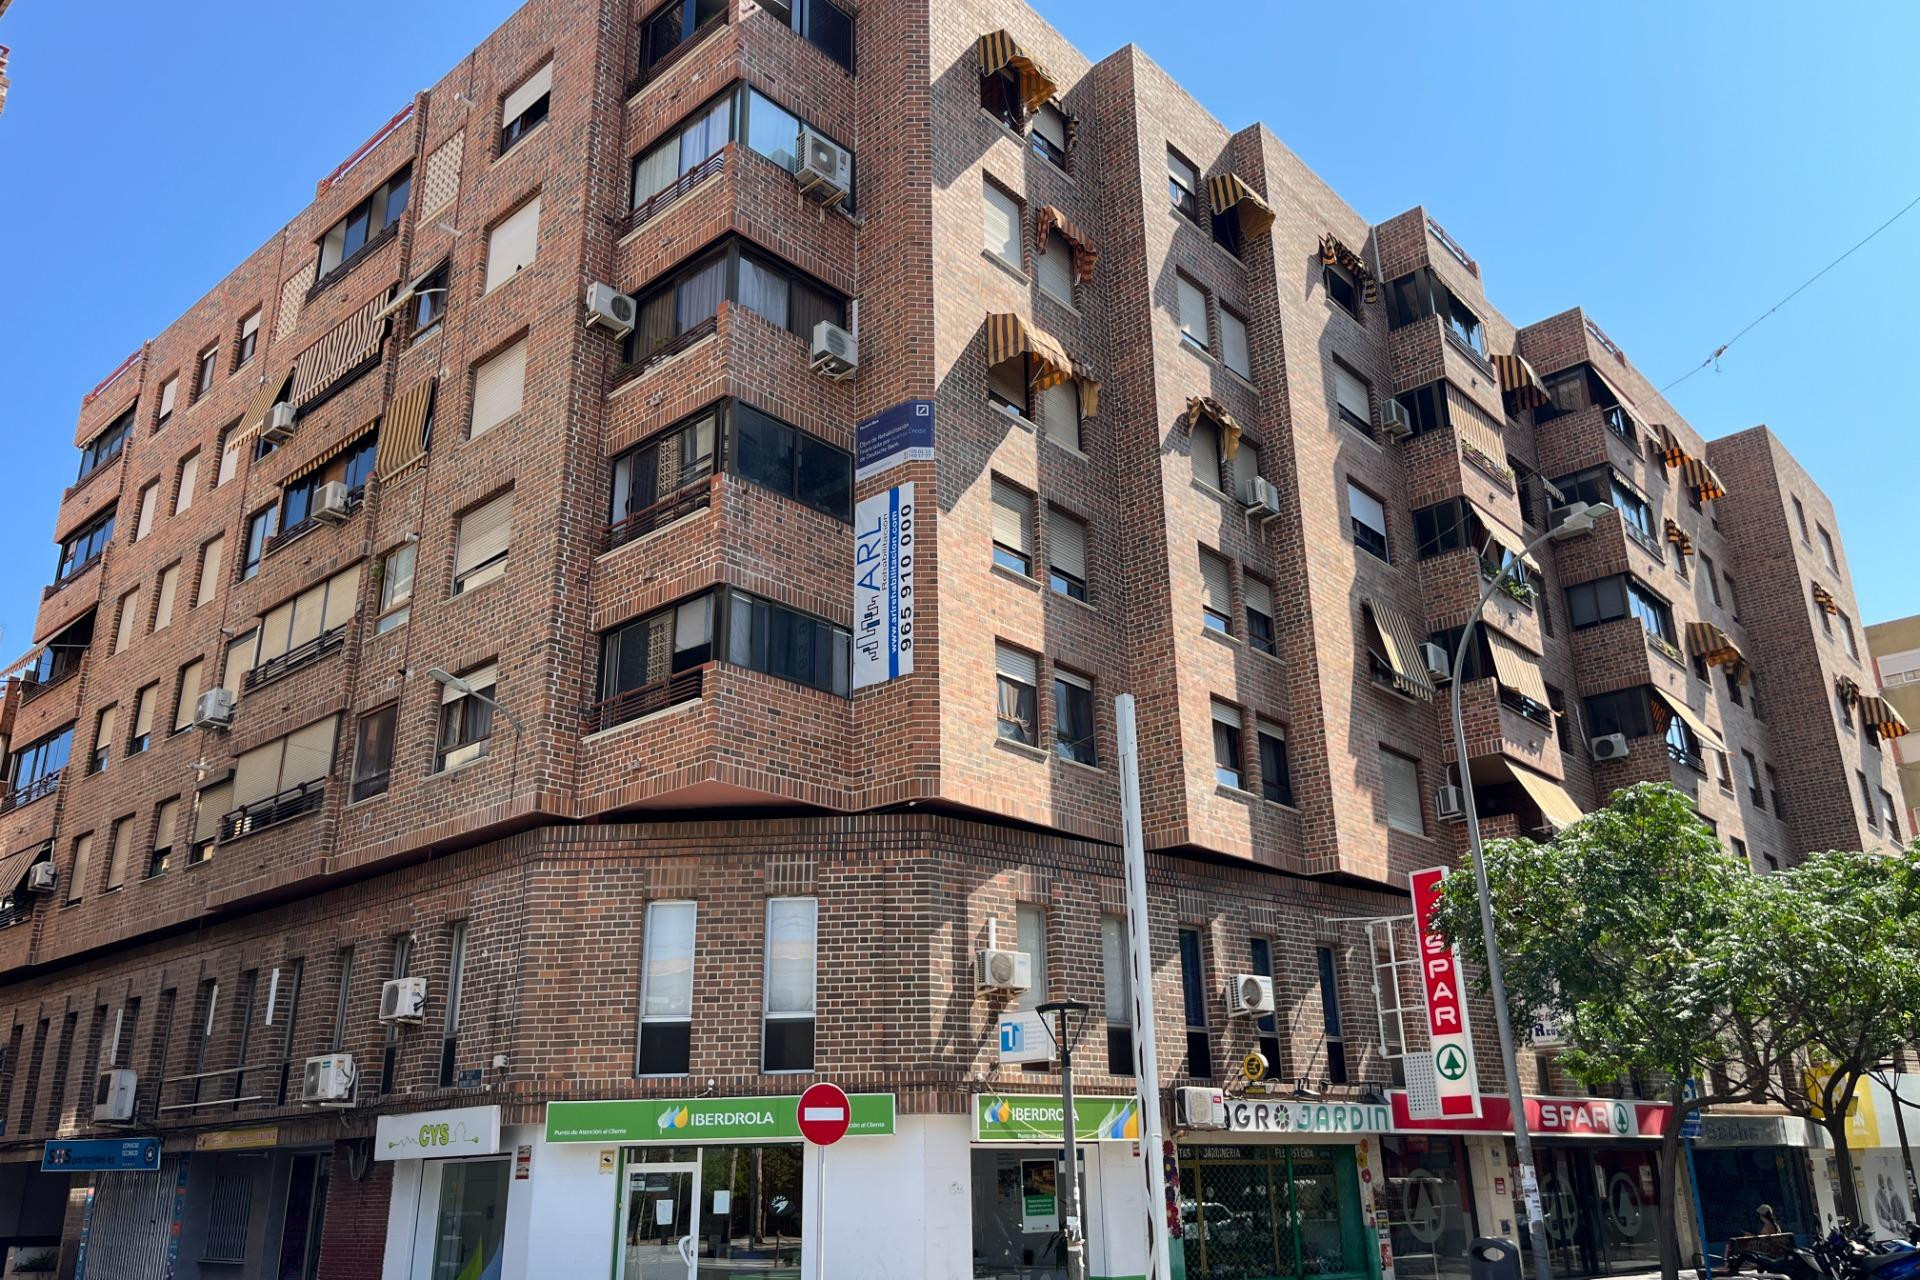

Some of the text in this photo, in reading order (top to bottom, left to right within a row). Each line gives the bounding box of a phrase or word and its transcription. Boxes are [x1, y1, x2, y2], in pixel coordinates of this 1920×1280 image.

[857, 516, 882, 592] ARL
[891, 510, 899, 654] www.arlrehabilitacion.com
[900, 504, 913, 652] 965 910 000
[1425, 934, 1457, 1027] SPAR
[691, 1111, 774, 1127] IBERDROLA
[866, 1121, 885, 1129] Cliente
[1012, 1107, 1079, 1121] IBERDROA
[1296, 1105, 1389, 1131] JARDIN
[1541, 1104, 1609, 1129] SPAR
[419, 1123, 449, 1147] CYS
[578, 1128, 602, 1136] Atención
